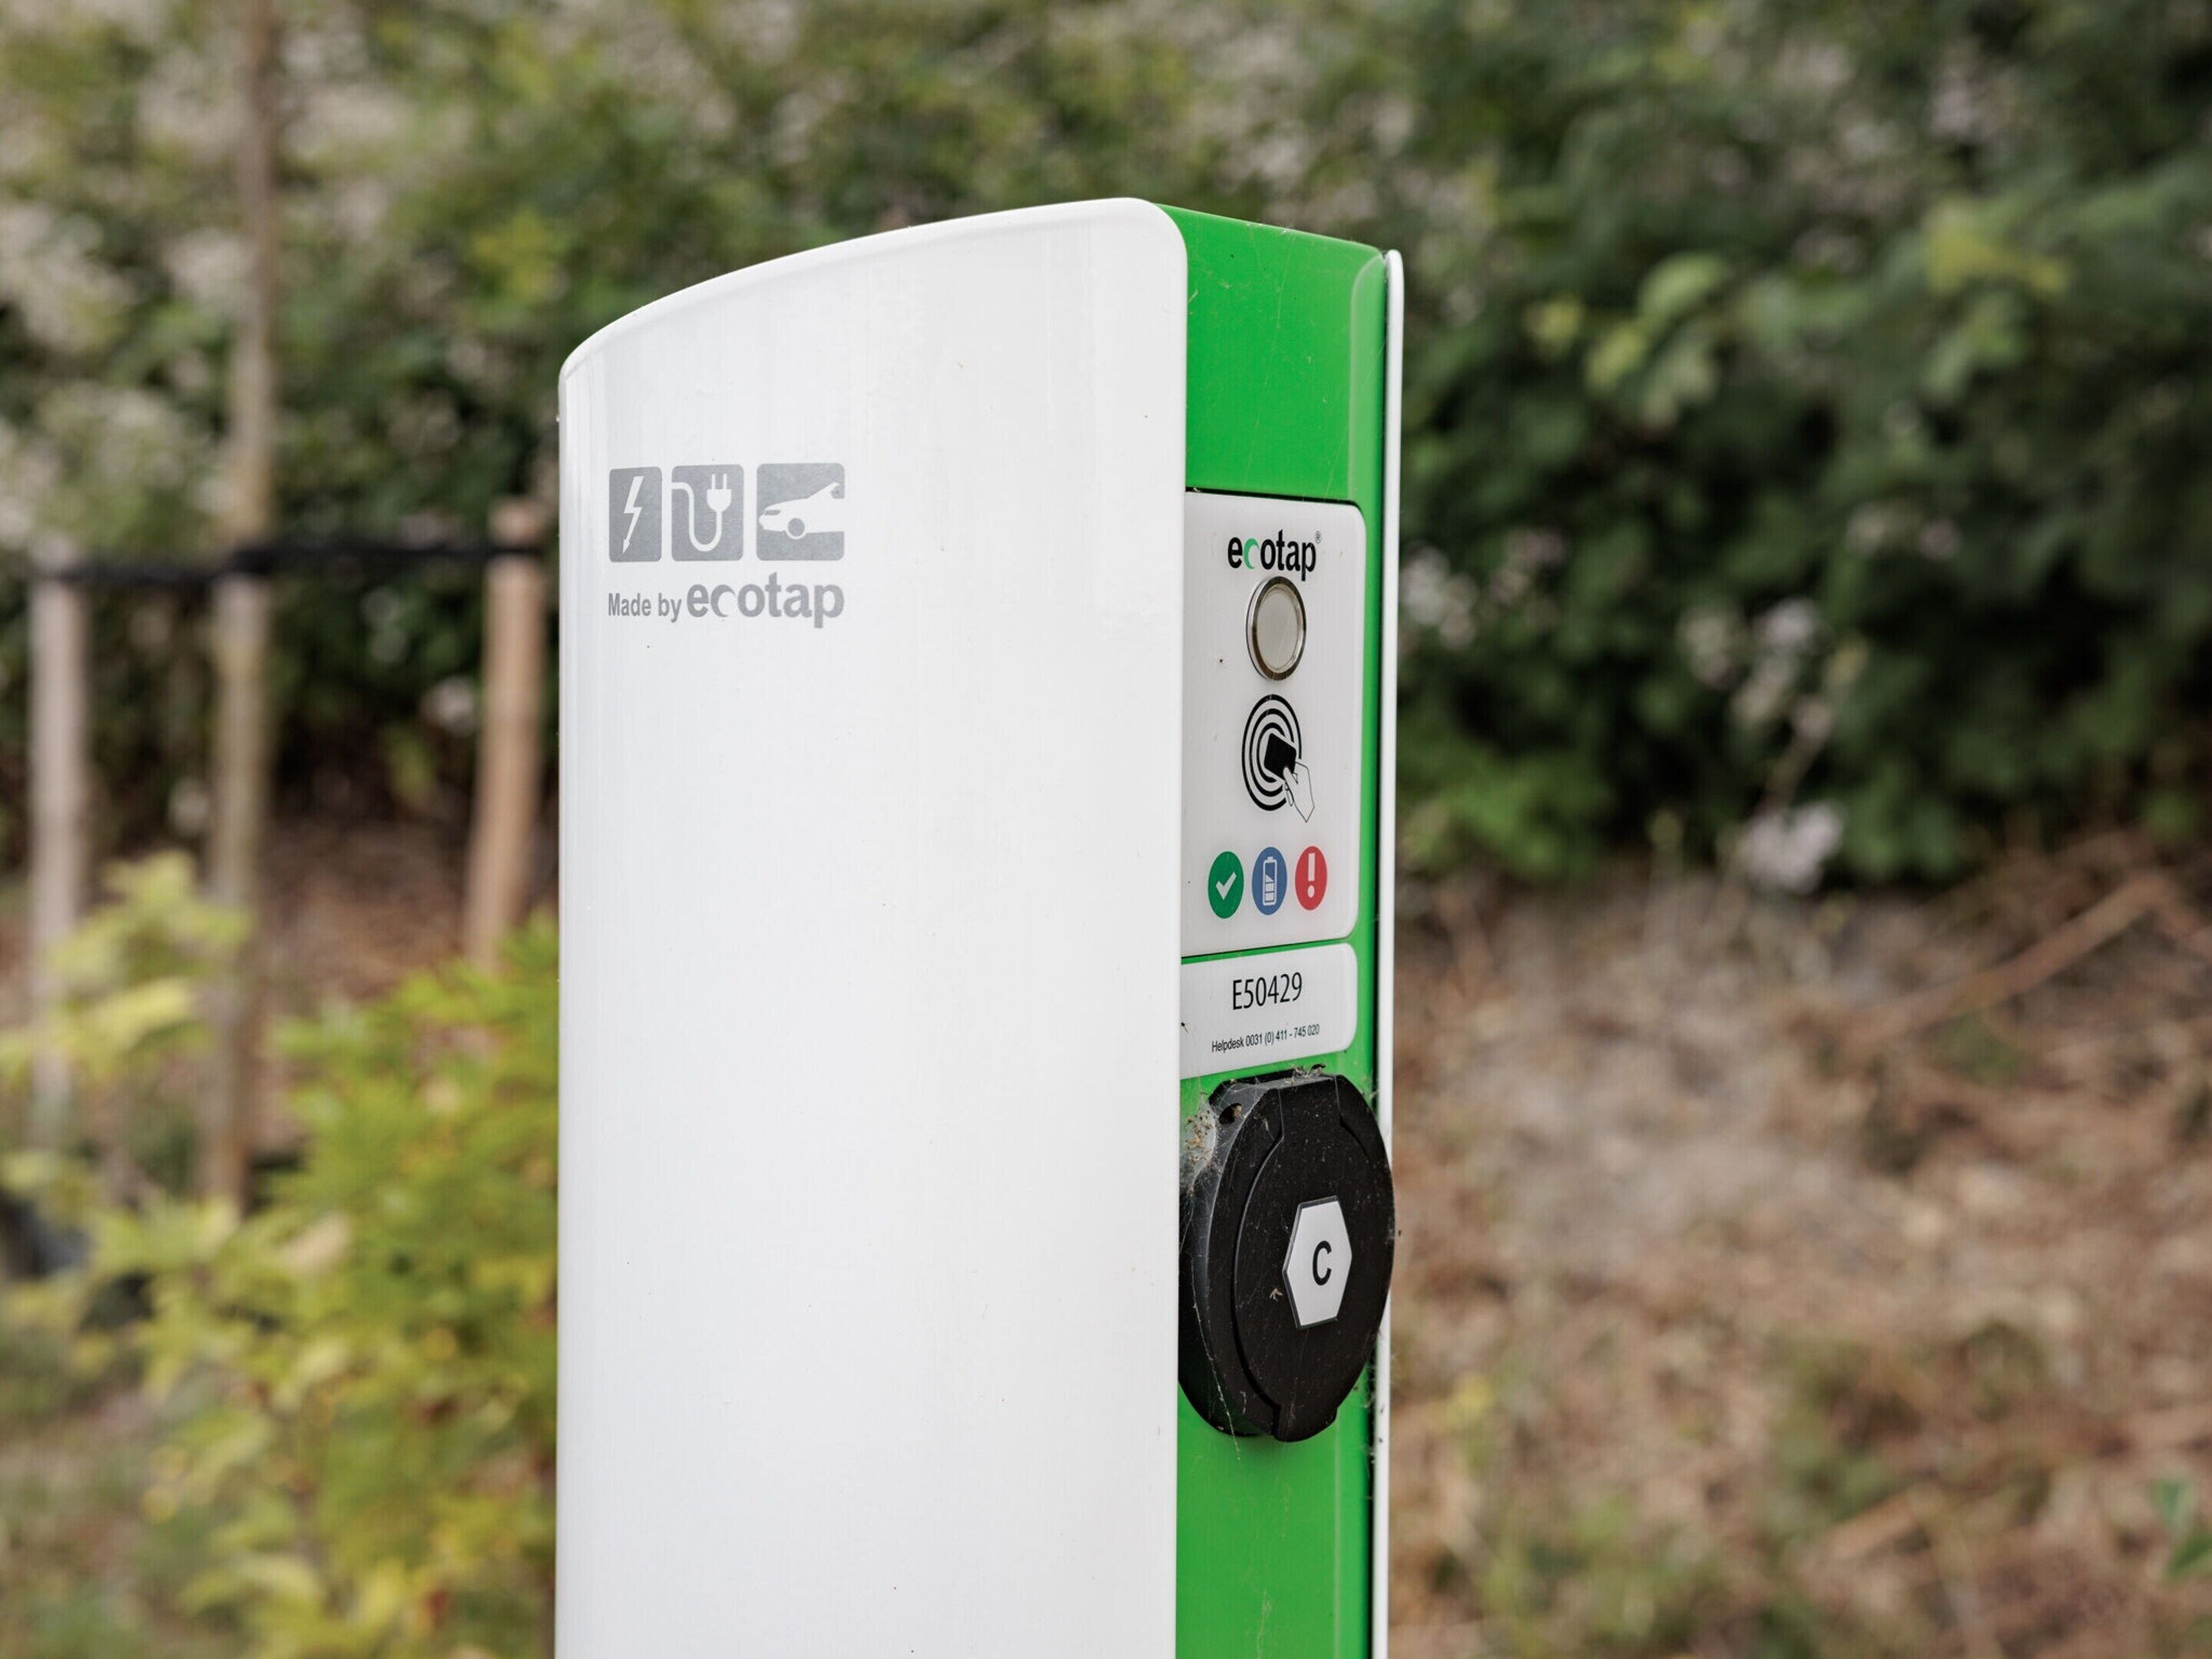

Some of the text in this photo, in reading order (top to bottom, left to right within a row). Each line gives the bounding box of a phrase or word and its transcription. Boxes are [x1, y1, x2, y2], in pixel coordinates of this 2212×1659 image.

[608, 571, 845, 629] Made by ecotap
[1232, 972, 1303, 1010] E50429
[1211, 1037, 1244, 1053] Helpdesk
[1246, 1033, 1262, 1046] 0031
[1264, 1031, 1274, 1046] (0)
[1276, 1029, 1287, 1041] 411
[1293, 1025, 1306, 1038] 745
[1307, 1024, 1320, 1036] 020
[1312, 1240, 1332, 1286] C
